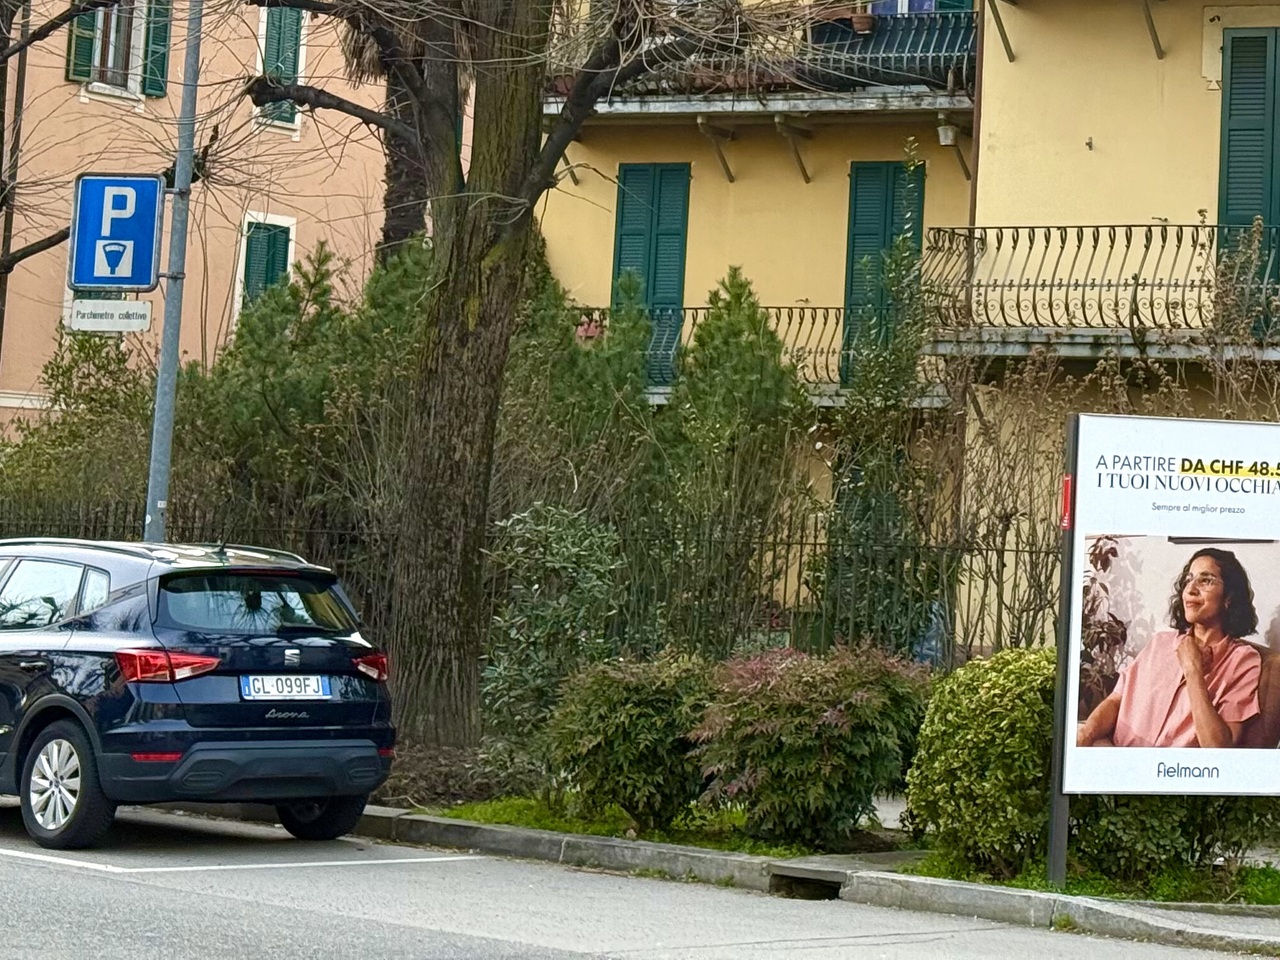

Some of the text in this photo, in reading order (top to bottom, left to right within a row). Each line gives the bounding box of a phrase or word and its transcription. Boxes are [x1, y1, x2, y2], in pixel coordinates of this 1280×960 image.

[101, 186, 136, 237] P
[76, 310, 114, 321] Parchimetro
[1096, 455, 1108, 470] A
[1112, 455, 1176, 473] PARTIRE
[1181, 458, 1206, 473] DA
[1210, 459, 1243, 475] CHF
[1097, 473, 1102, 488] I
[1106, 473, 1149, 490] TUOI
[1154, 475, 1211, 492] NUOVI
[1151, 502, 1246, 515] Sempre al miglior prezzo
